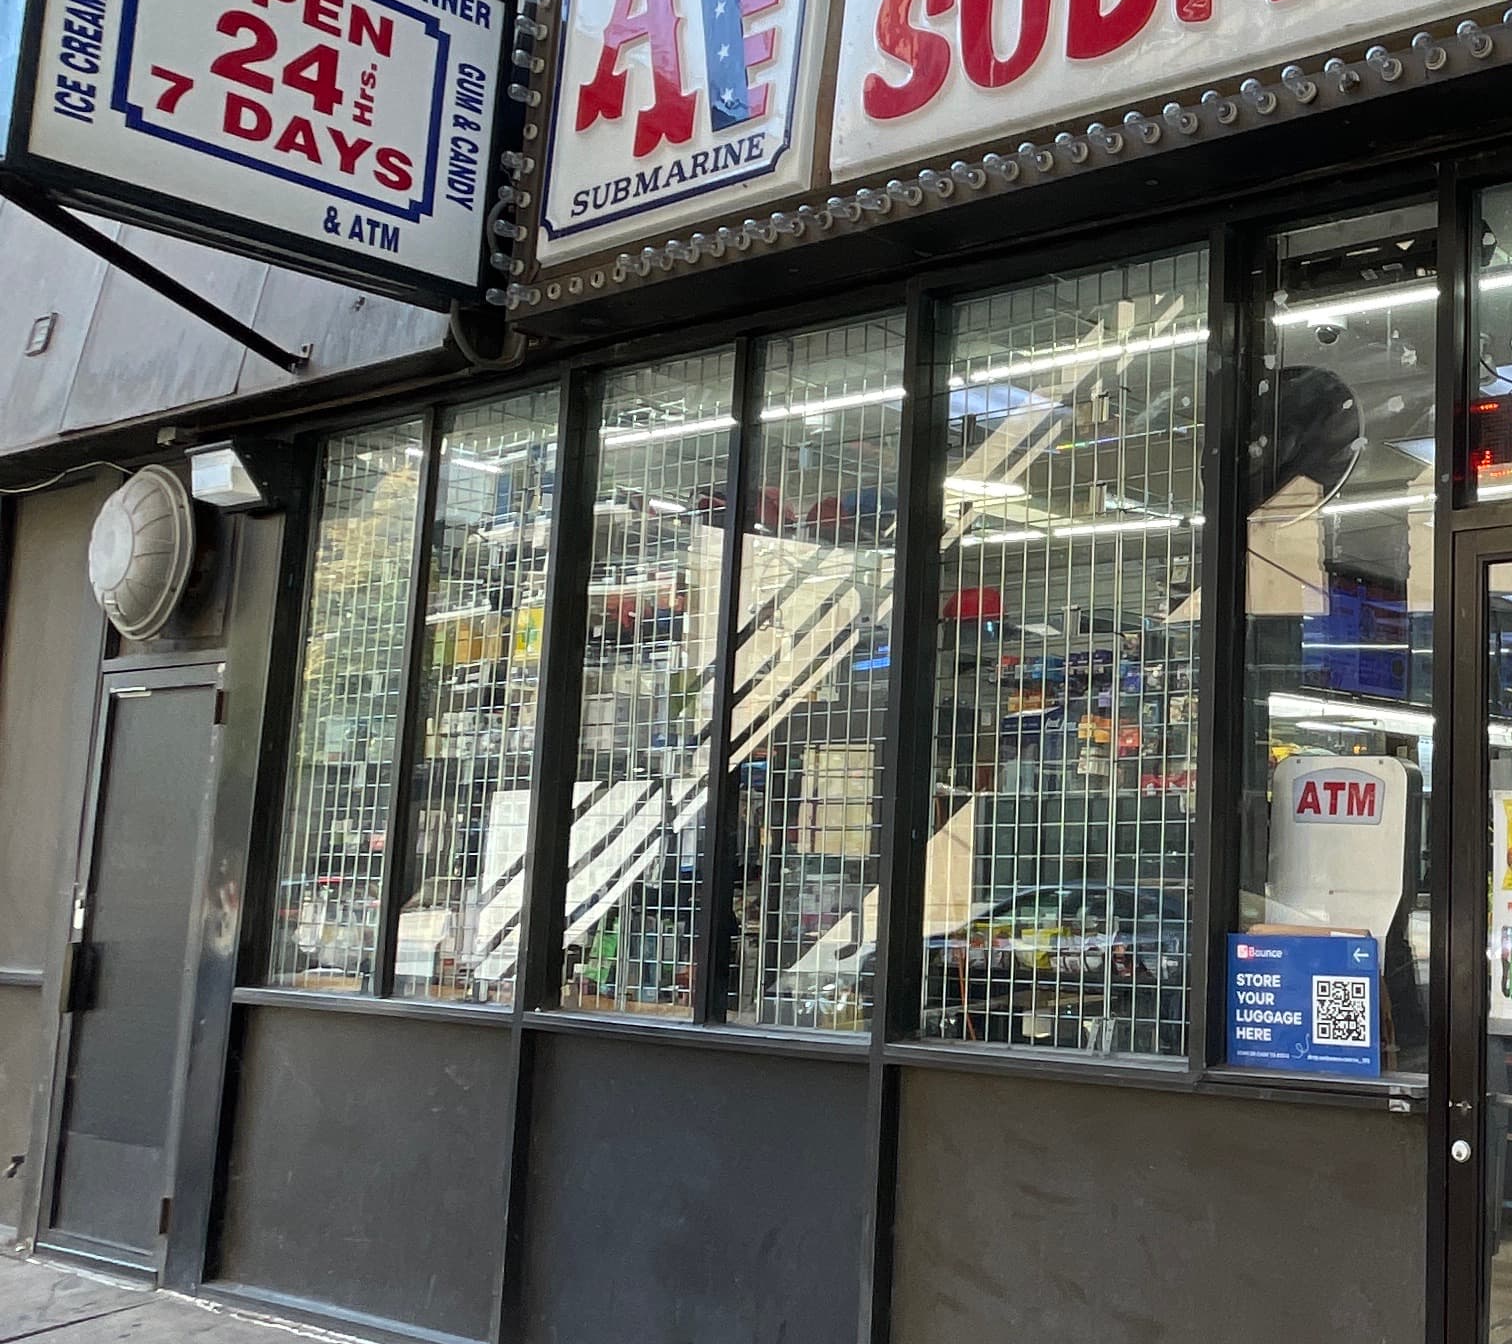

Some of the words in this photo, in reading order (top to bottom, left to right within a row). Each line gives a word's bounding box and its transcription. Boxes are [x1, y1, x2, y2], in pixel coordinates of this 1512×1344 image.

[210, 10, 343, 116] 24
[352, 62, 379, 128] Hrs.
[455, 62, 487, 116] GUM
[54, 80, 95, 123] ICE
[151, 65, 195, 114] 7
[222, 90, 414, 193] DAYS
[451, 116, 467, 132] &
[446, 133, 480, 211] CANDY
[571, 133, 765, 218] SUBMARINE
[324, 205, 340, 236] &
[348, 214, 401, 253] ATM
[1296, 781, 1376, 817] ATM
[1236, 973, 1281, 988] STORE
[1236, 991, 1275, 1006] YOUR
[1236, 1009, 1302, 1025] LUGGAGE
[1236, 1027, 1272, 1041] HERE
